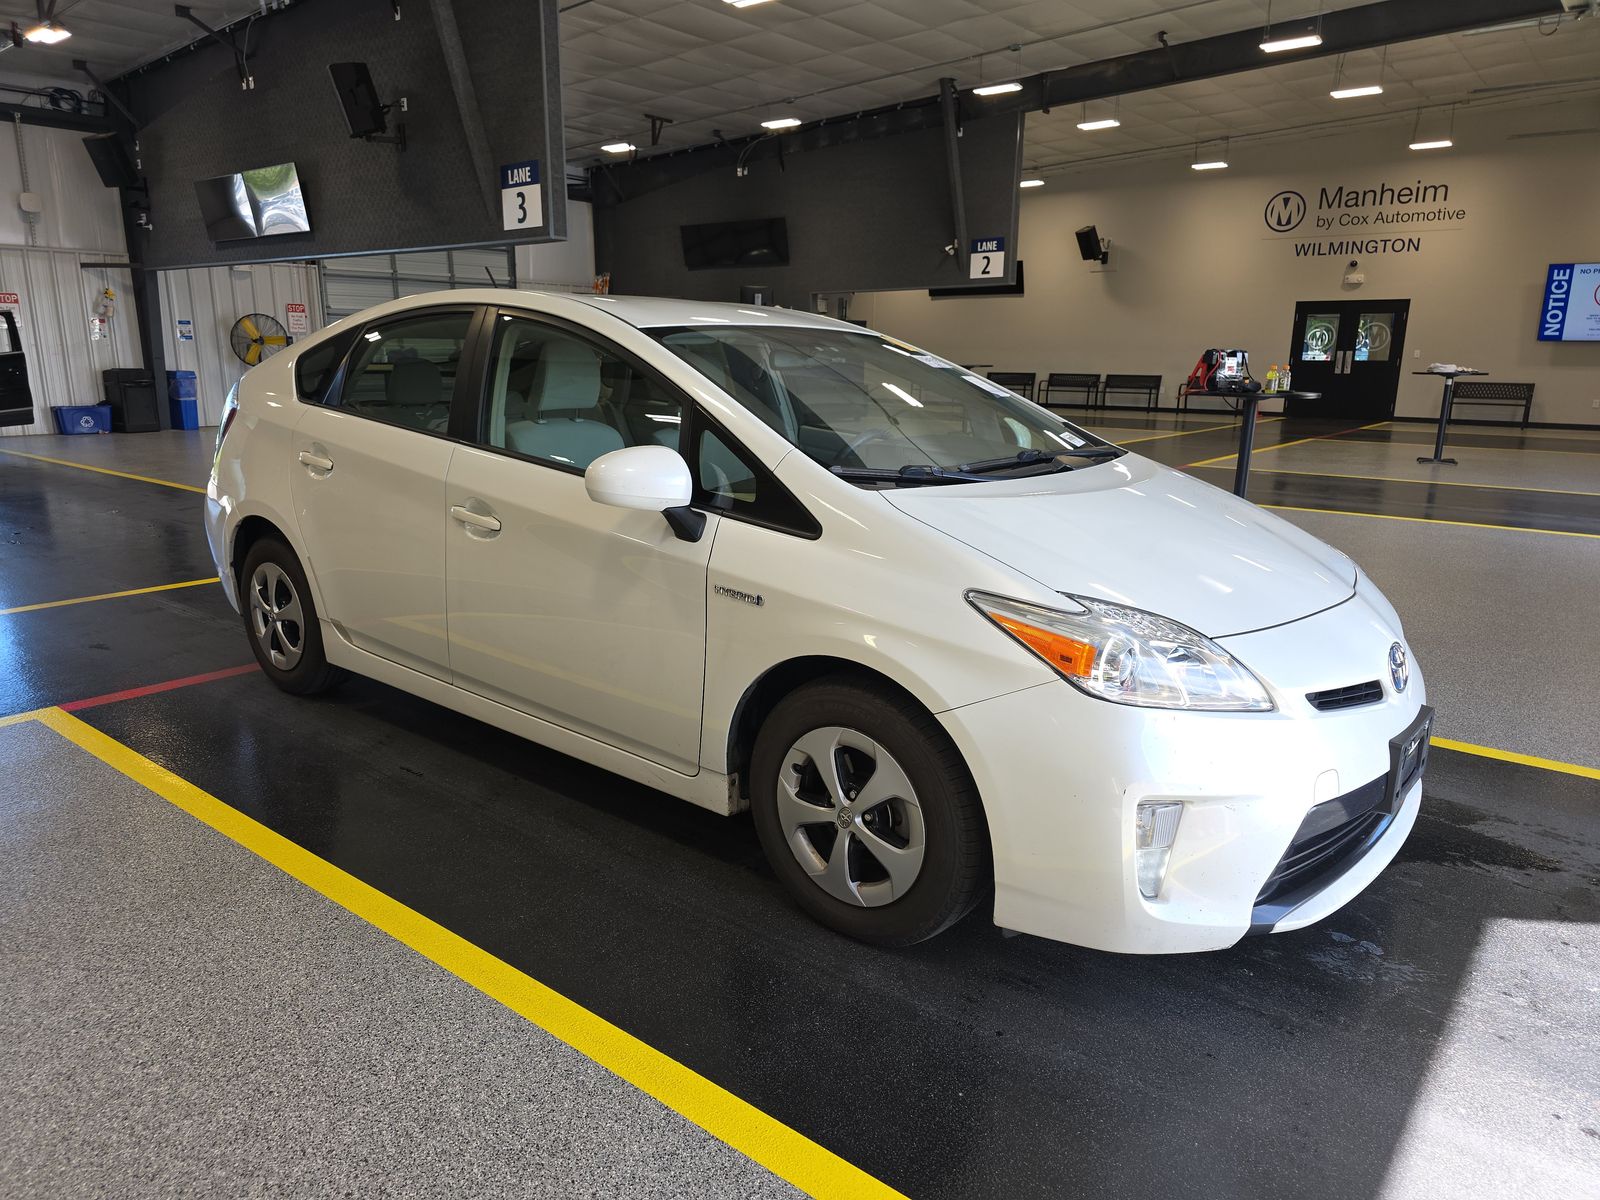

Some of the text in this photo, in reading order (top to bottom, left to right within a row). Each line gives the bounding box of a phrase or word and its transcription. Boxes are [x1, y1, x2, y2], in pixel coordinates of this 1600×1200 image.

[507, 167, 531, 184] LANE
[1318, 180, 1449, 210] Manheim
[516, 191, 527, 224] 3
[1316, 208, 1466, 230] by Cox Automotive
[977, 241, 998, 252] LANE
[1294, 237, 1421, 257] WILMINGTON
[981, 255, 990, 275] 2
[288, 304, 305, 312] STOP
[1544, 269, 1570, 336] NOTICE
